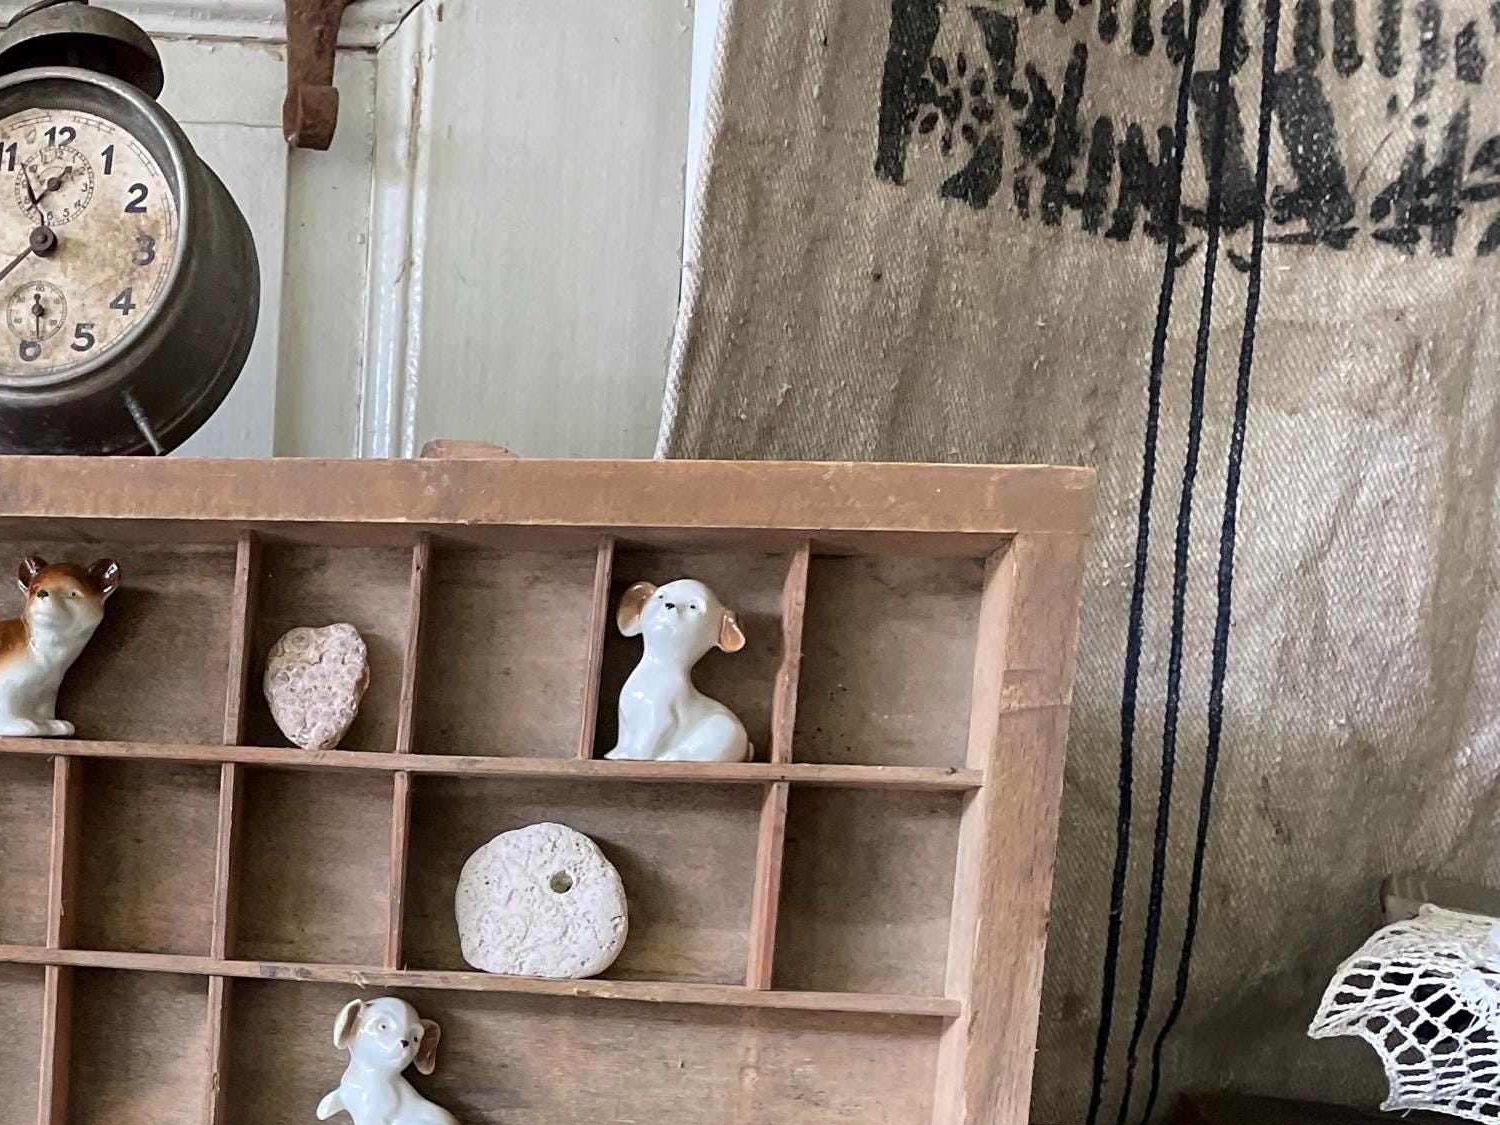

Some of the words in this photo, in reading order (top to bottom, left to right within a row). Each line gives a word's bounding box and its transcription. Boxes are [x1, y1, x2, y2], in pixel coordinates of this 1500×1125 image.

[44, 126, 77, 148] 12
[101, 144, 115, 175] 1
[125, 183, 149, 213] 2
[132, 234, 156, 266] 3
[109, 287, 136, 316] 4
[70, 323, 95, 352] 5
